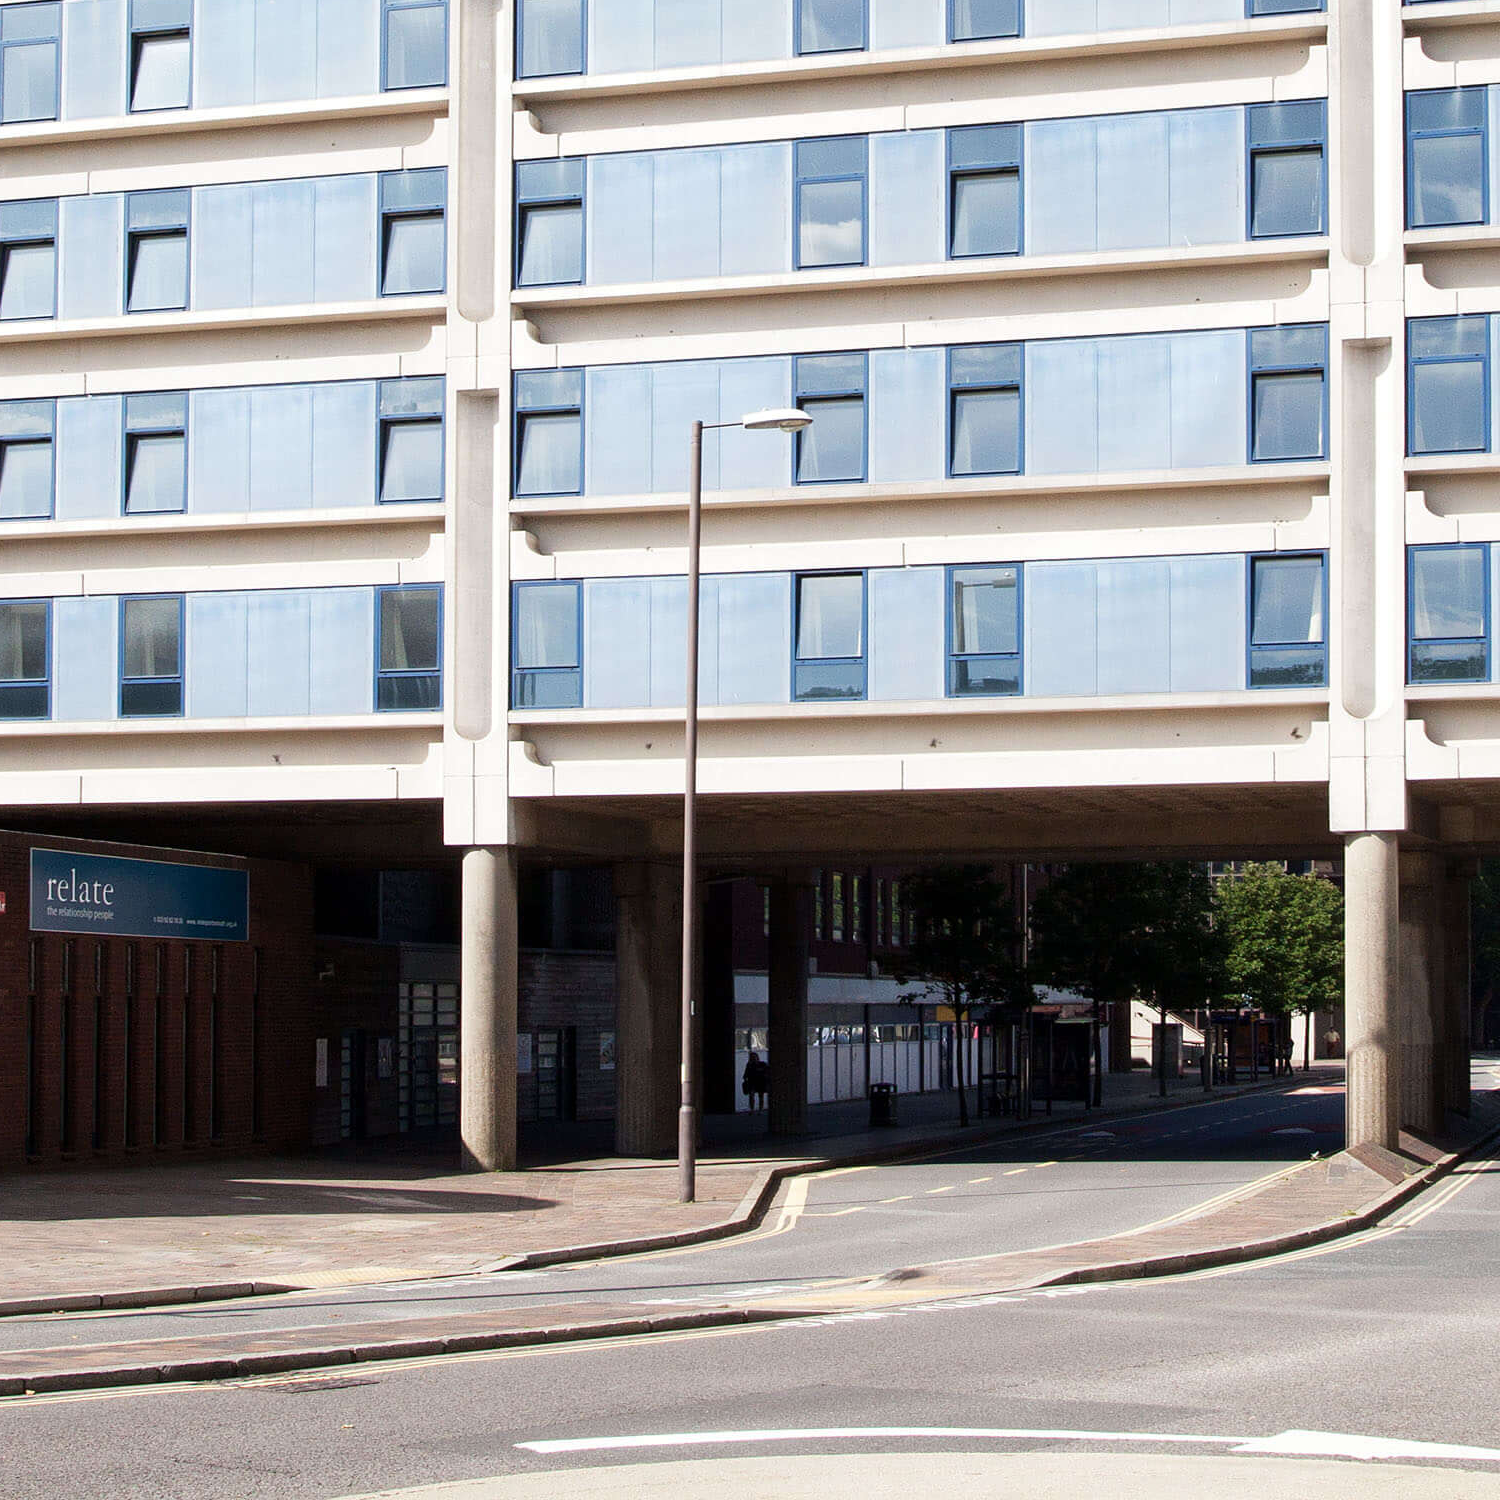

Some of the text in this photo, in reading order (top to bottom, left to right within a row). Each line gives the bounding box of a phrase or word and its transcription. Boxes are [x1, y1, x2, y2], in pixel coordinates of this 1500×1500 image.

[47, 868, 114, 906] relate
[47, 906, 114, 921] the relationship people
